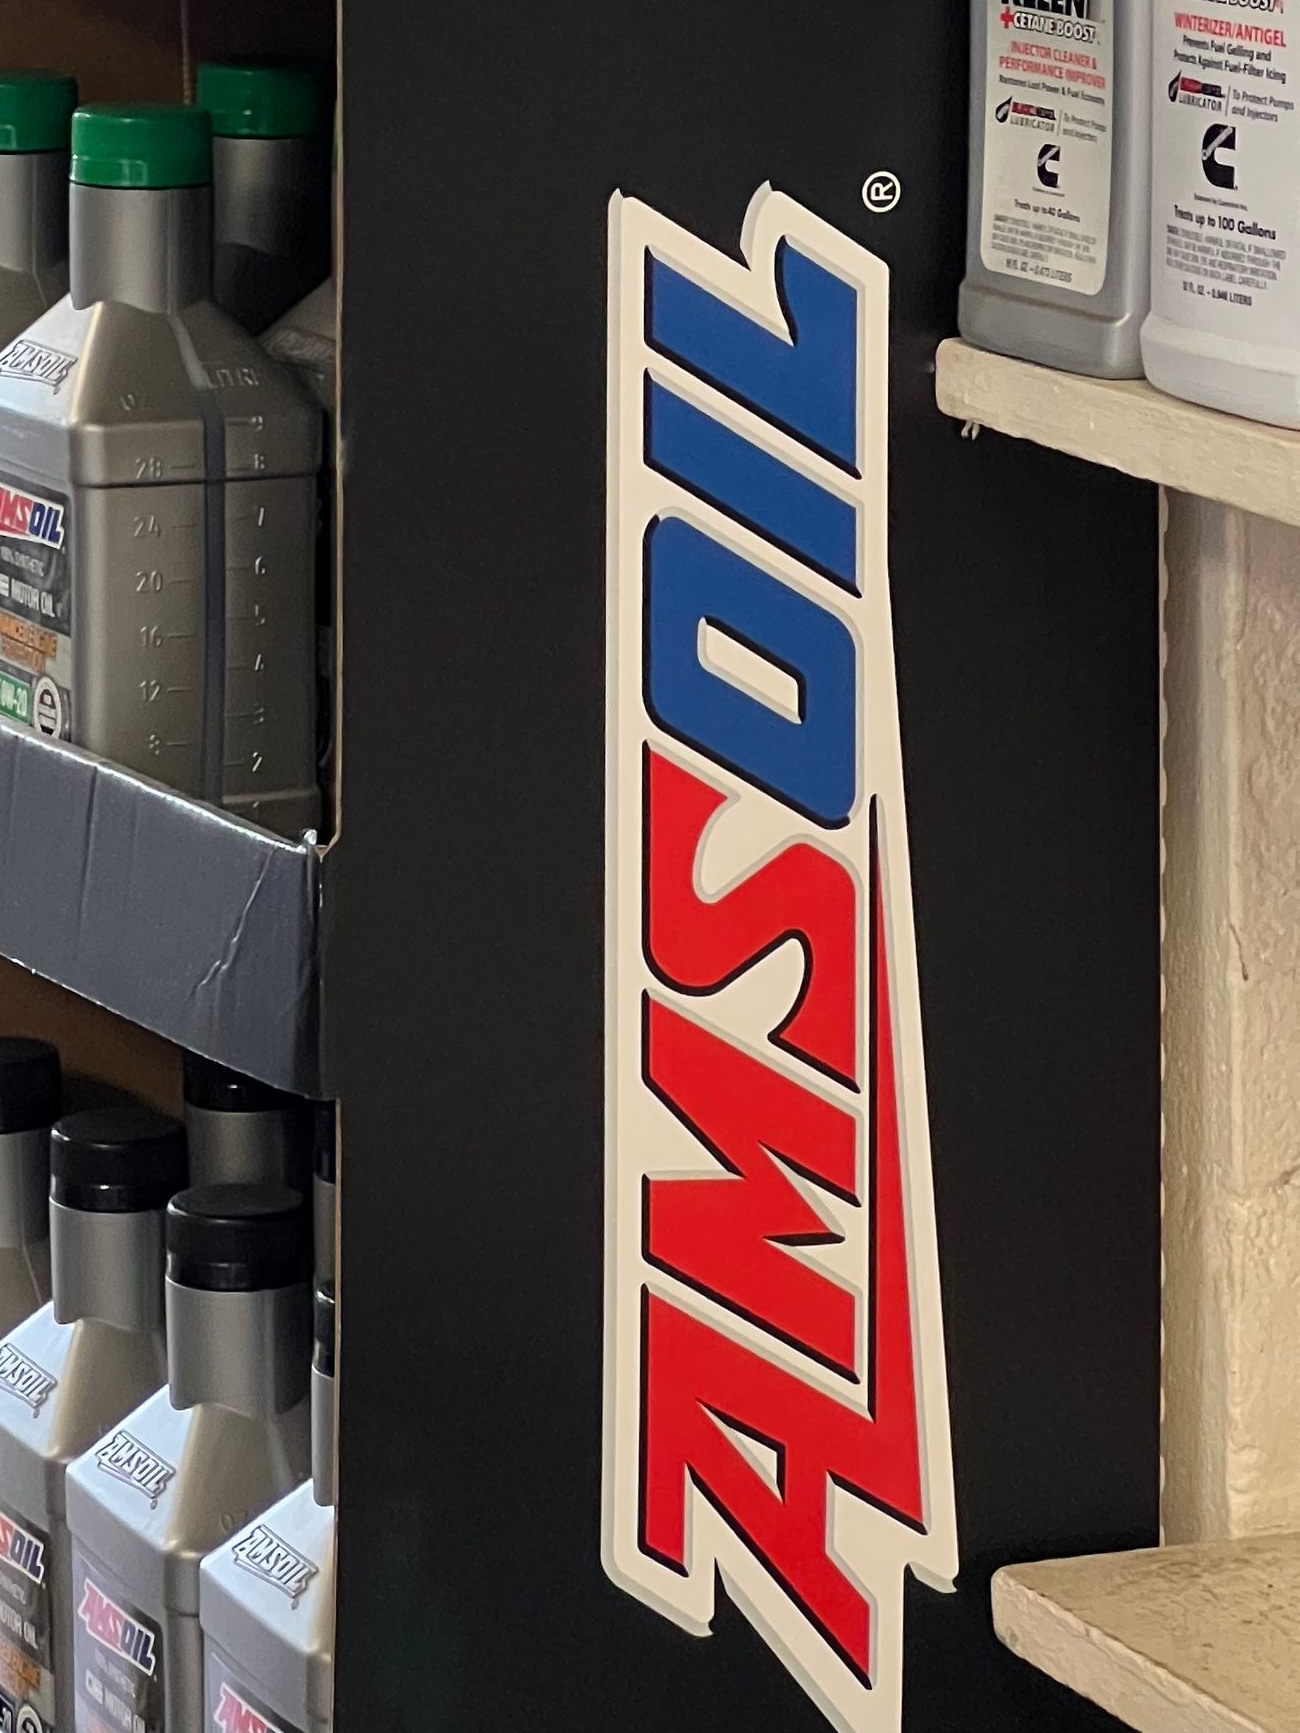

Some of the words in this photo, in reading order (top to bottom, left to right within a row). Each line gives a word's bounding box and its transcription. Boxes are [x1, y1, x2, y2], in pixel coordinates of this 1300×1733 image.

[1056, 20, 1095, 43] BOOST
[999, 56, 1063, 79] PERFORMANCE
[1011, 41, 1051, 60] INJECTOR
[1053, 48, 1090, 67] CLEANER
[1256, 48, 1272, 62] and
[1218, 215, 1235, 231] 100
[1237, 221, 1277, 240] Gallons
[11, 578, 39, 611] MOTOR
[40, 592, 56, 618] OIL
[636, 231, 930, 1691] AMSOIL
[95, 1429, 177, 1498] AMSOIL
[232, 1524, 320, 1598] AMSOIL
[77, 1577, 155, 1676] AMSOIL
